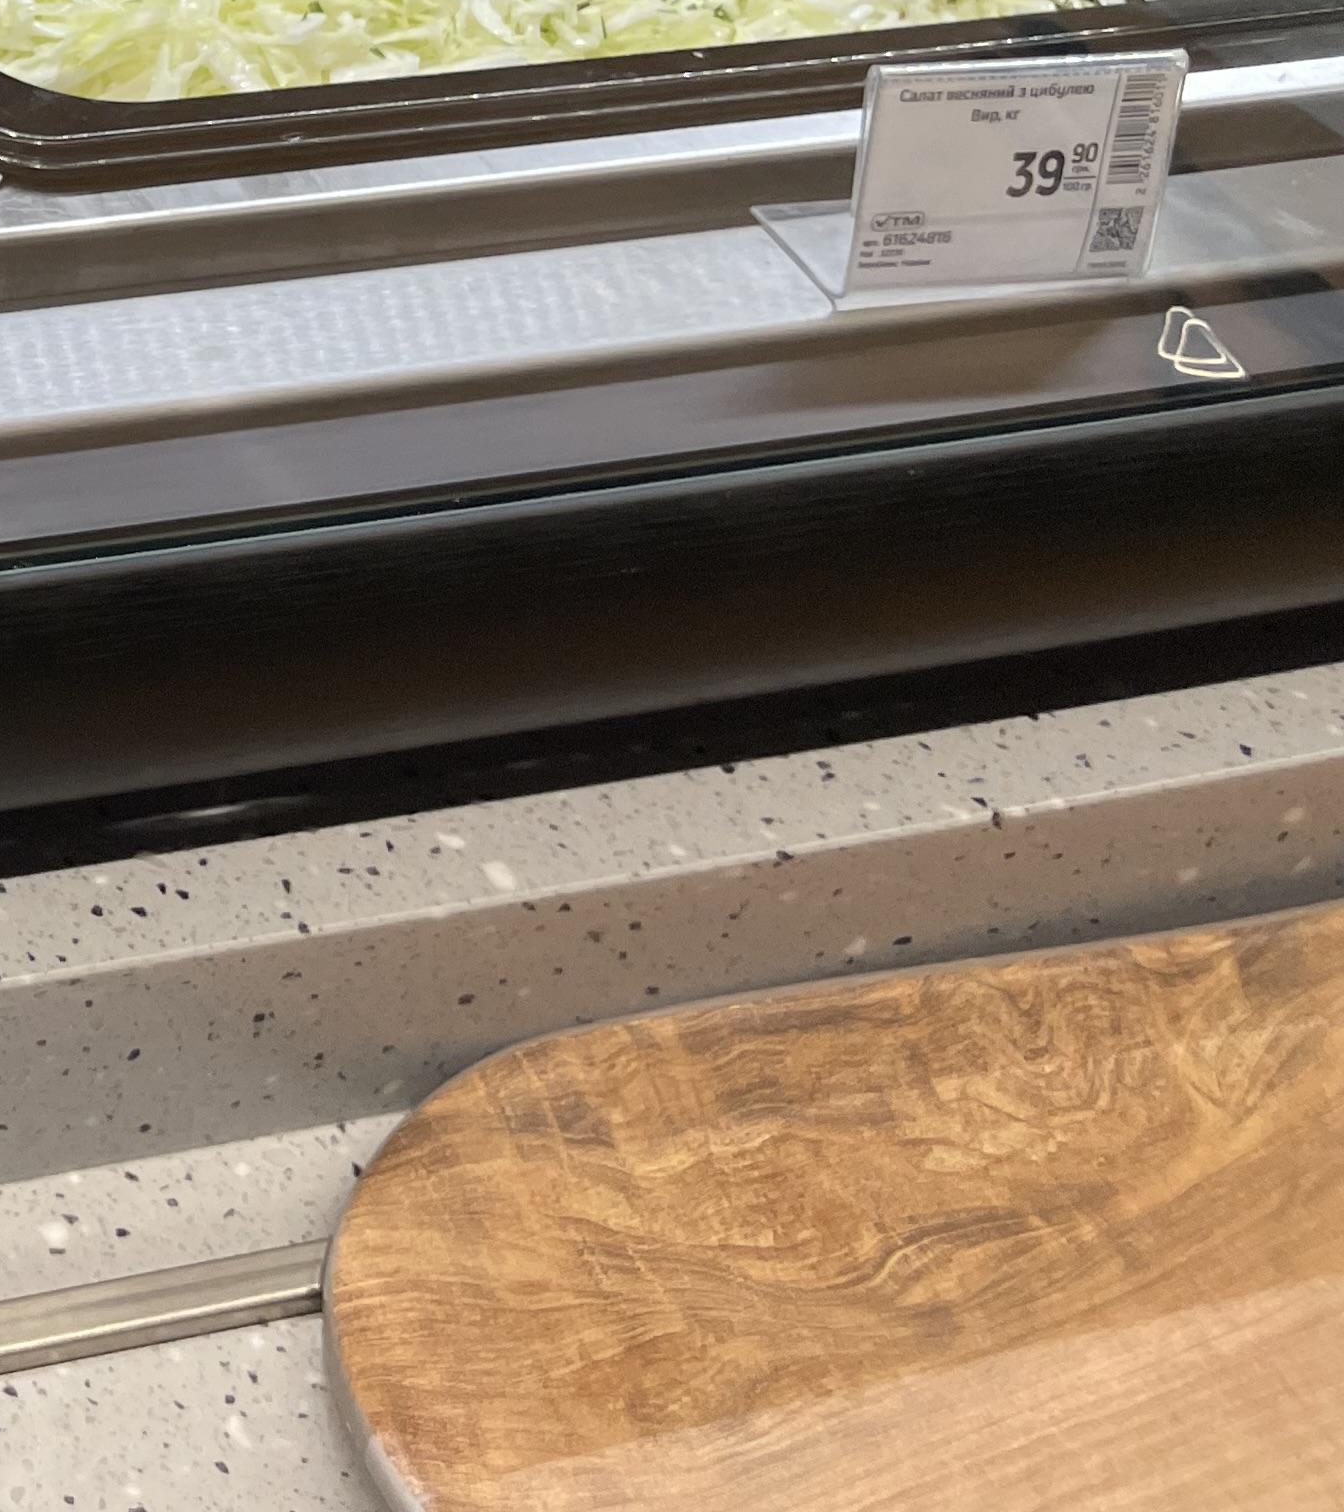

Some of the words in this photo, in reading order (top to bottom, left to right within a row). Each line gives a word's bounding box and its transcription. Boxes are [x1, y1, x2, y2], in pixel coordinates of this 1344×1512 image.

[900, 89, 942, 102] Салат
[1006, 150, 1065, 197] 39
[1072, 142, 1098, 163] 90
